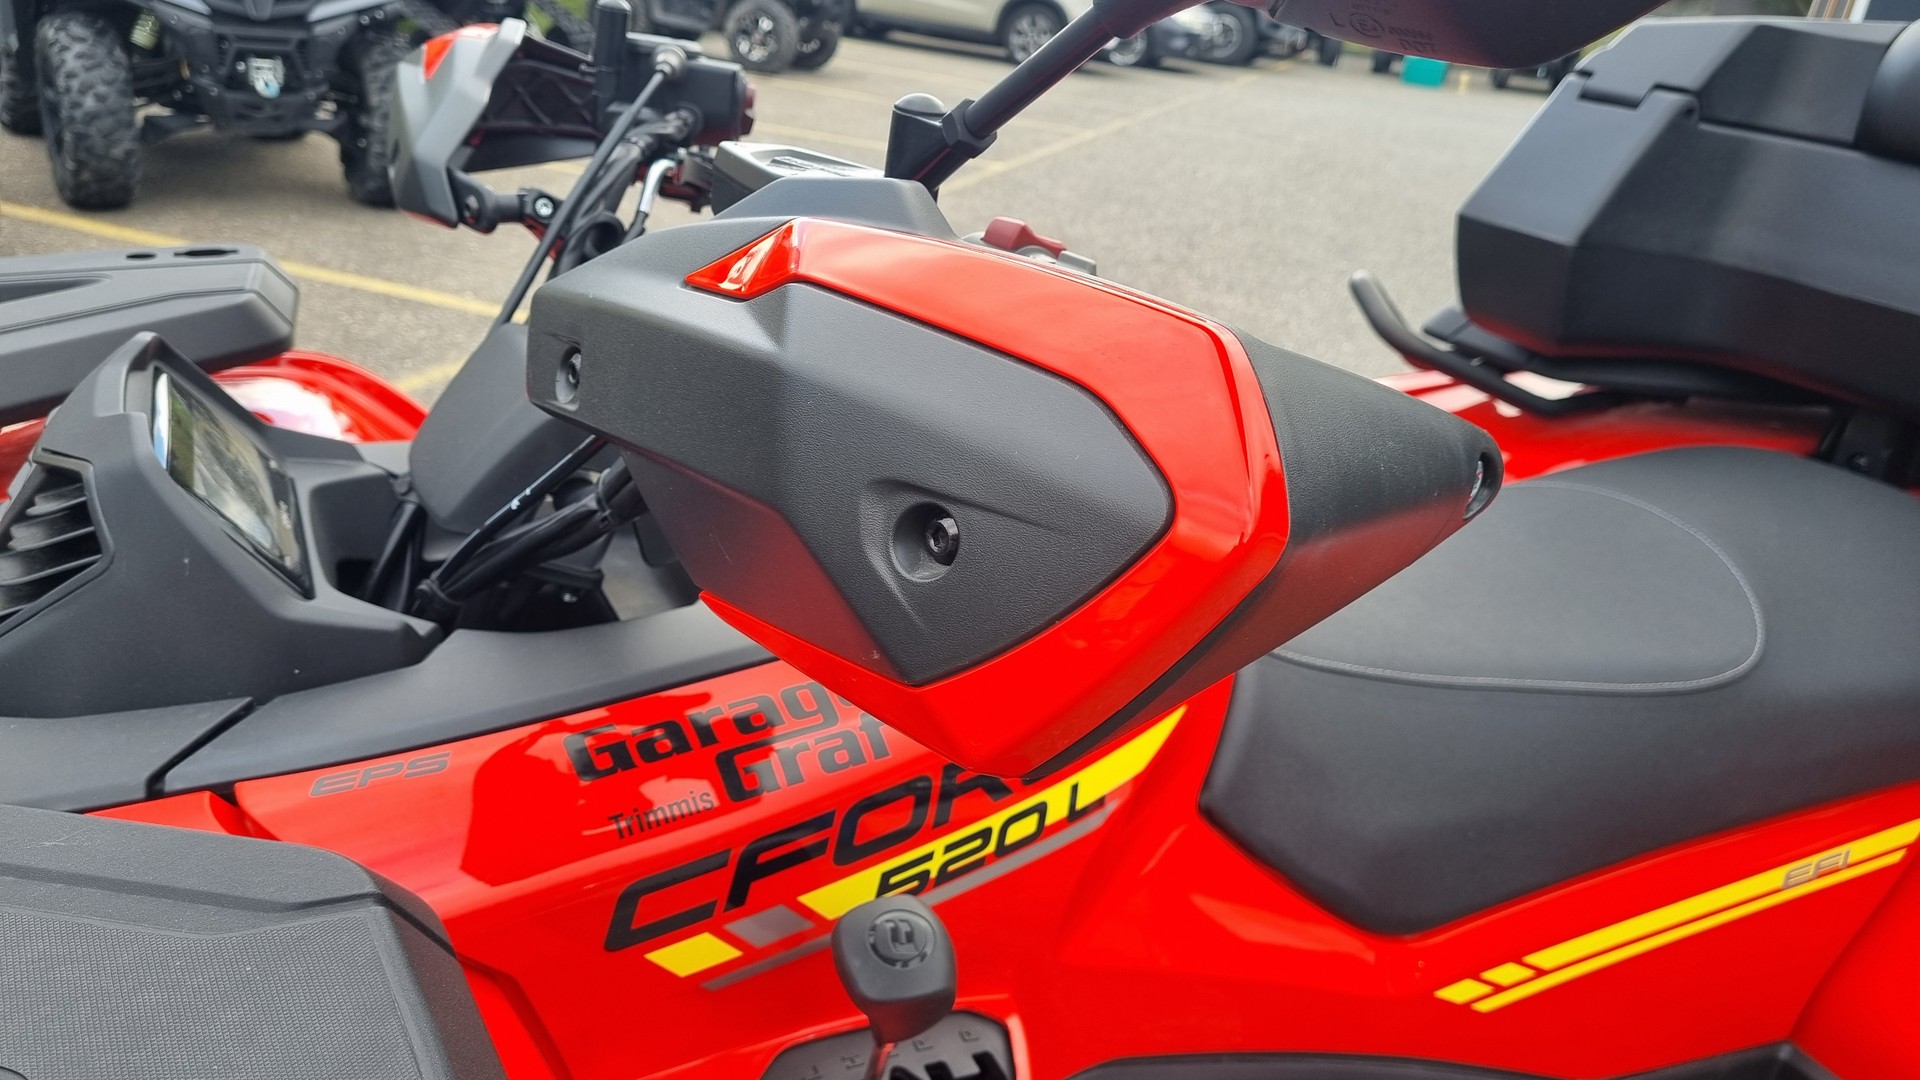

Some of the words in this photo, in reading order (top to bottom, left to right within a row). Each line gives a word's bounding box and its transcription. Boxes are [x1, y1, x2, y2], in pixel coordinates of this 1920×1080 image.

[563, 681, 853, 782] Garag
[310, 751, 452, 798] EPS
[609, 790, 715, 840] Trimmis
[875, 800, 1048, 899] 520
[1067, 781, 1106, 823] L
[604, 762, 1013, 952] CFOR
[1782, 849, 1851, 890] EFI
